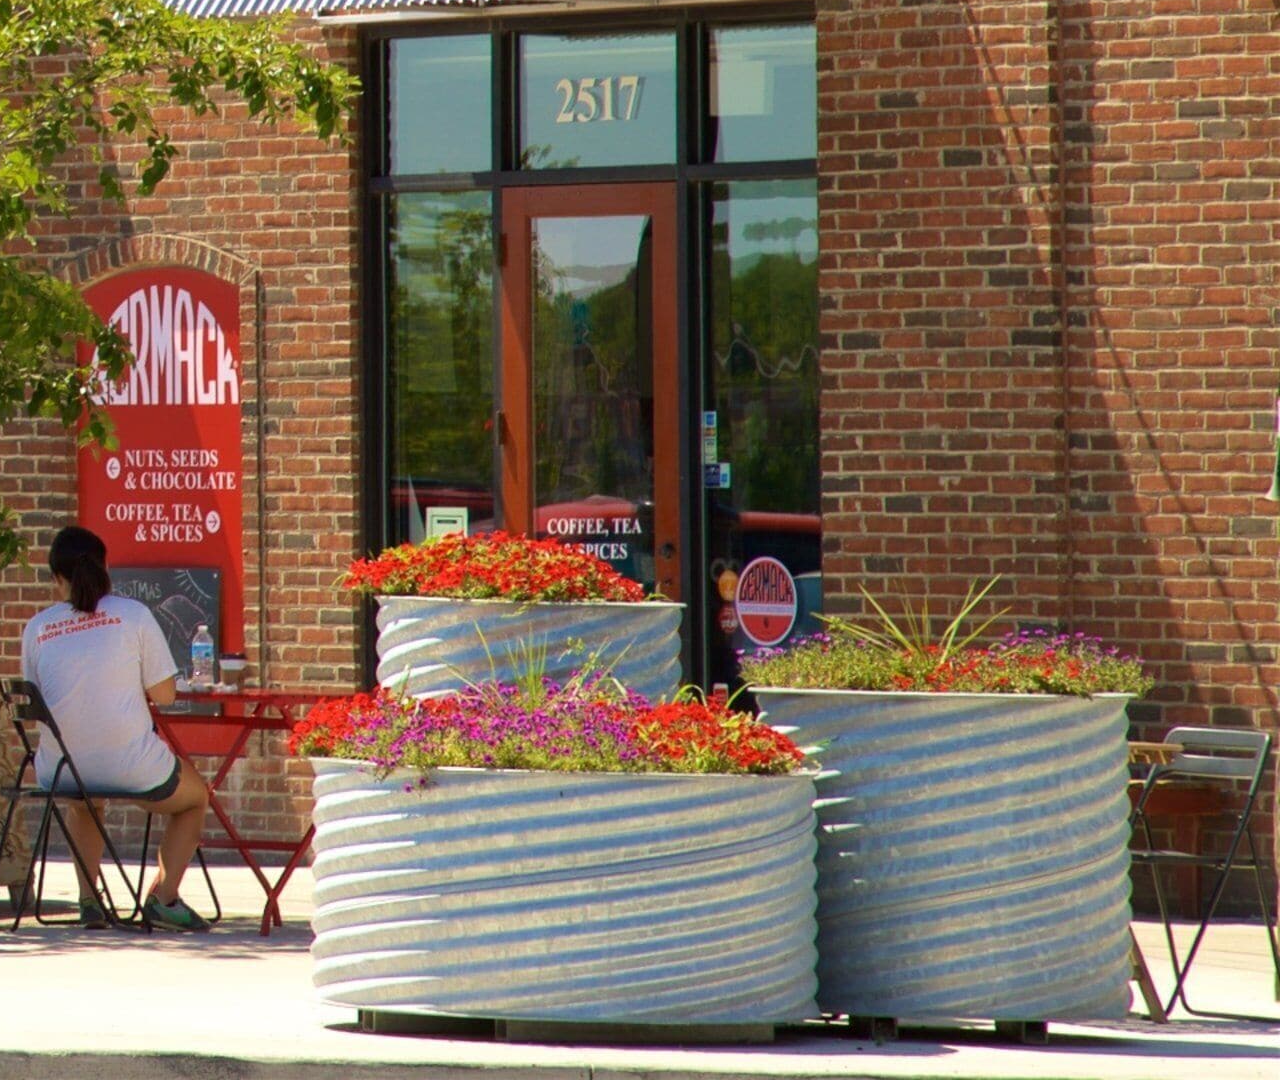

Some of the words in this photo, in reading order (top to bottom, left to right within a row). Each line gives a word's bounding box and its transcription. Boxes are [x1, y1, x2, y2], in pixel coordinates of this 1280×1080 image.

[556, 76, 642, 123] 2517
[124, 449, 168, 471] NUTS,
[171, 449, 219, 468] SEEDS
[124, 471, 137, 490] &
[140, 471, 237, 490] CHOCOLATE
[105, 503, 169, 525] COFFEE,
[172, 503, 203, 522] TEA
[135, 523, 147, 542] &
[150, 524, 203, 543] SPICES
[547, 518, 609, 537] COFFEE,
[612, 518, 642, 535] TEA
[45, 619, 75, 631] PASTA
[64, 617, 122, 635] CHICKPEAS
